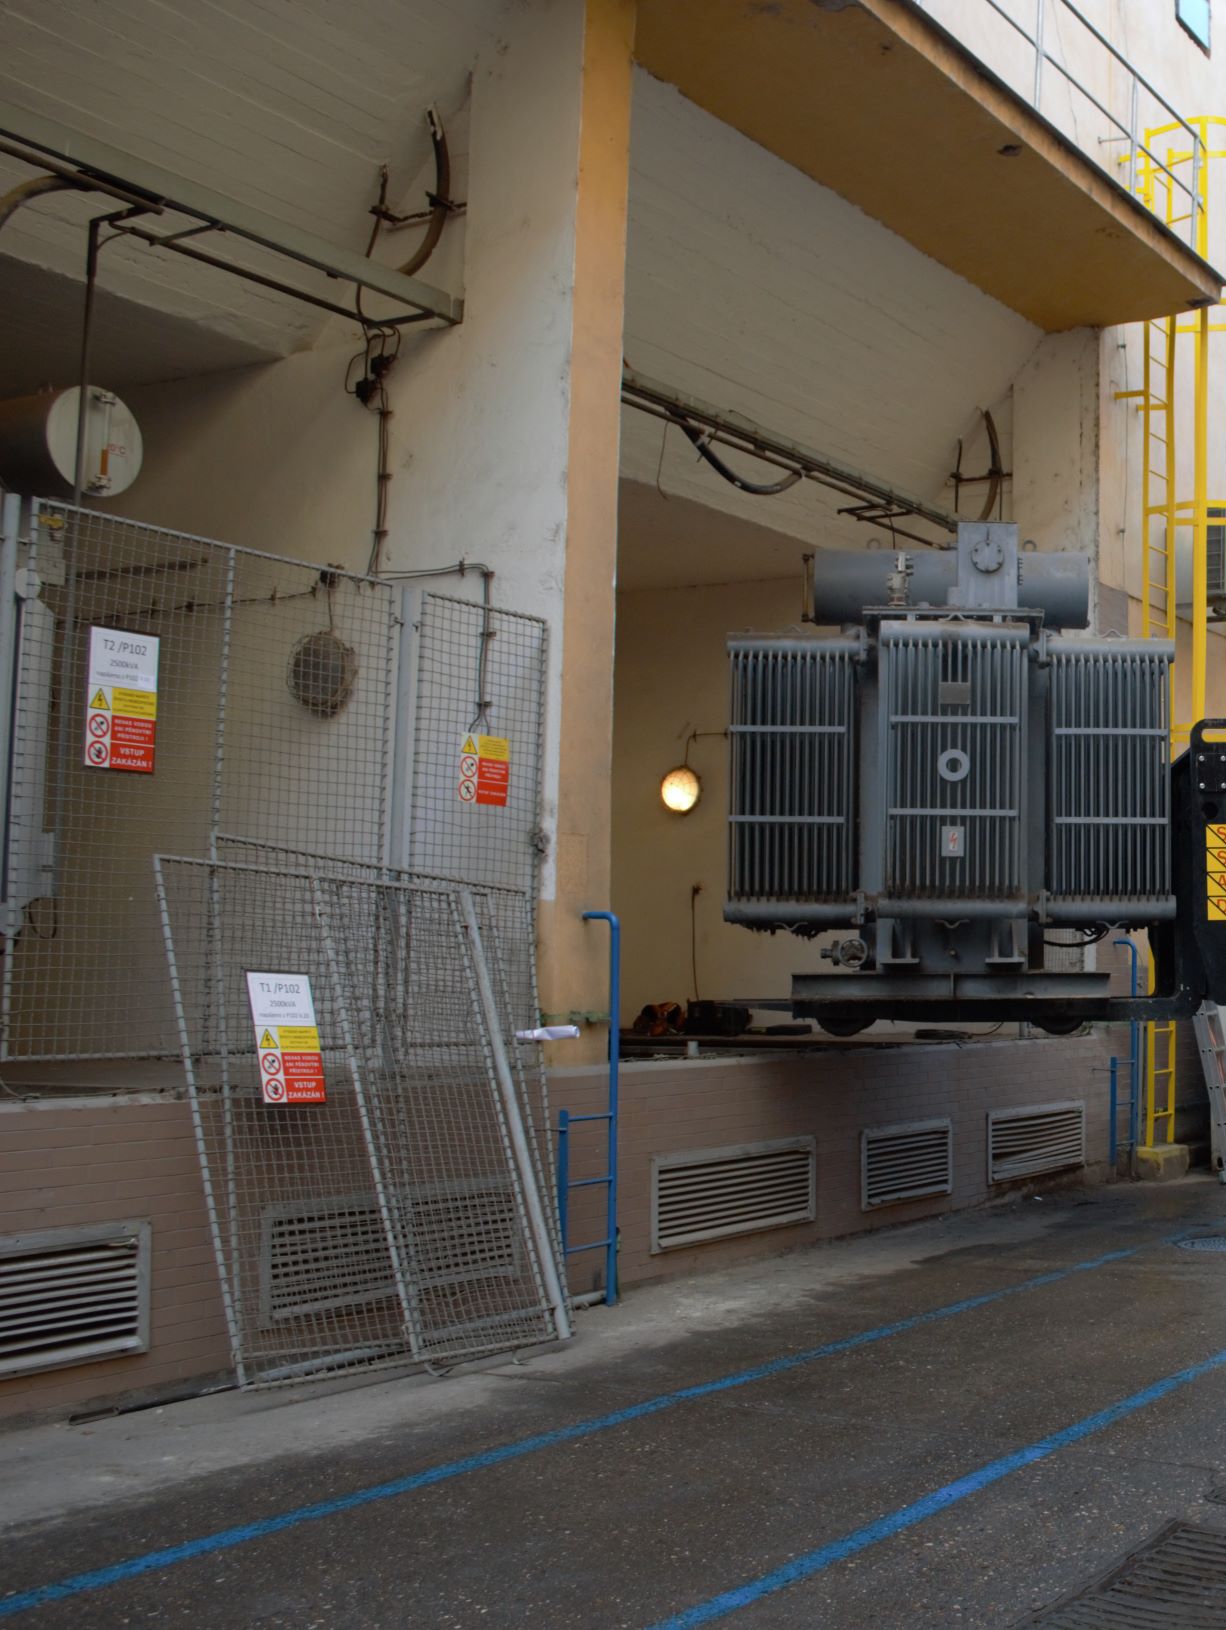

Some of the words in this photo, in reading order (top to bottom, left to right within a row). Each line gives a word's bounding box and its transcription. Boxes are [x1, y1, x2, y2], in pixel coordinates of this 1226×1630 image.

[103, 639, 115, 651] T2
[120, 747, 144, 757] VSTUP
[259, 982, 271, 993] T1
[294, 1081, 317, 1089] VSTUP
